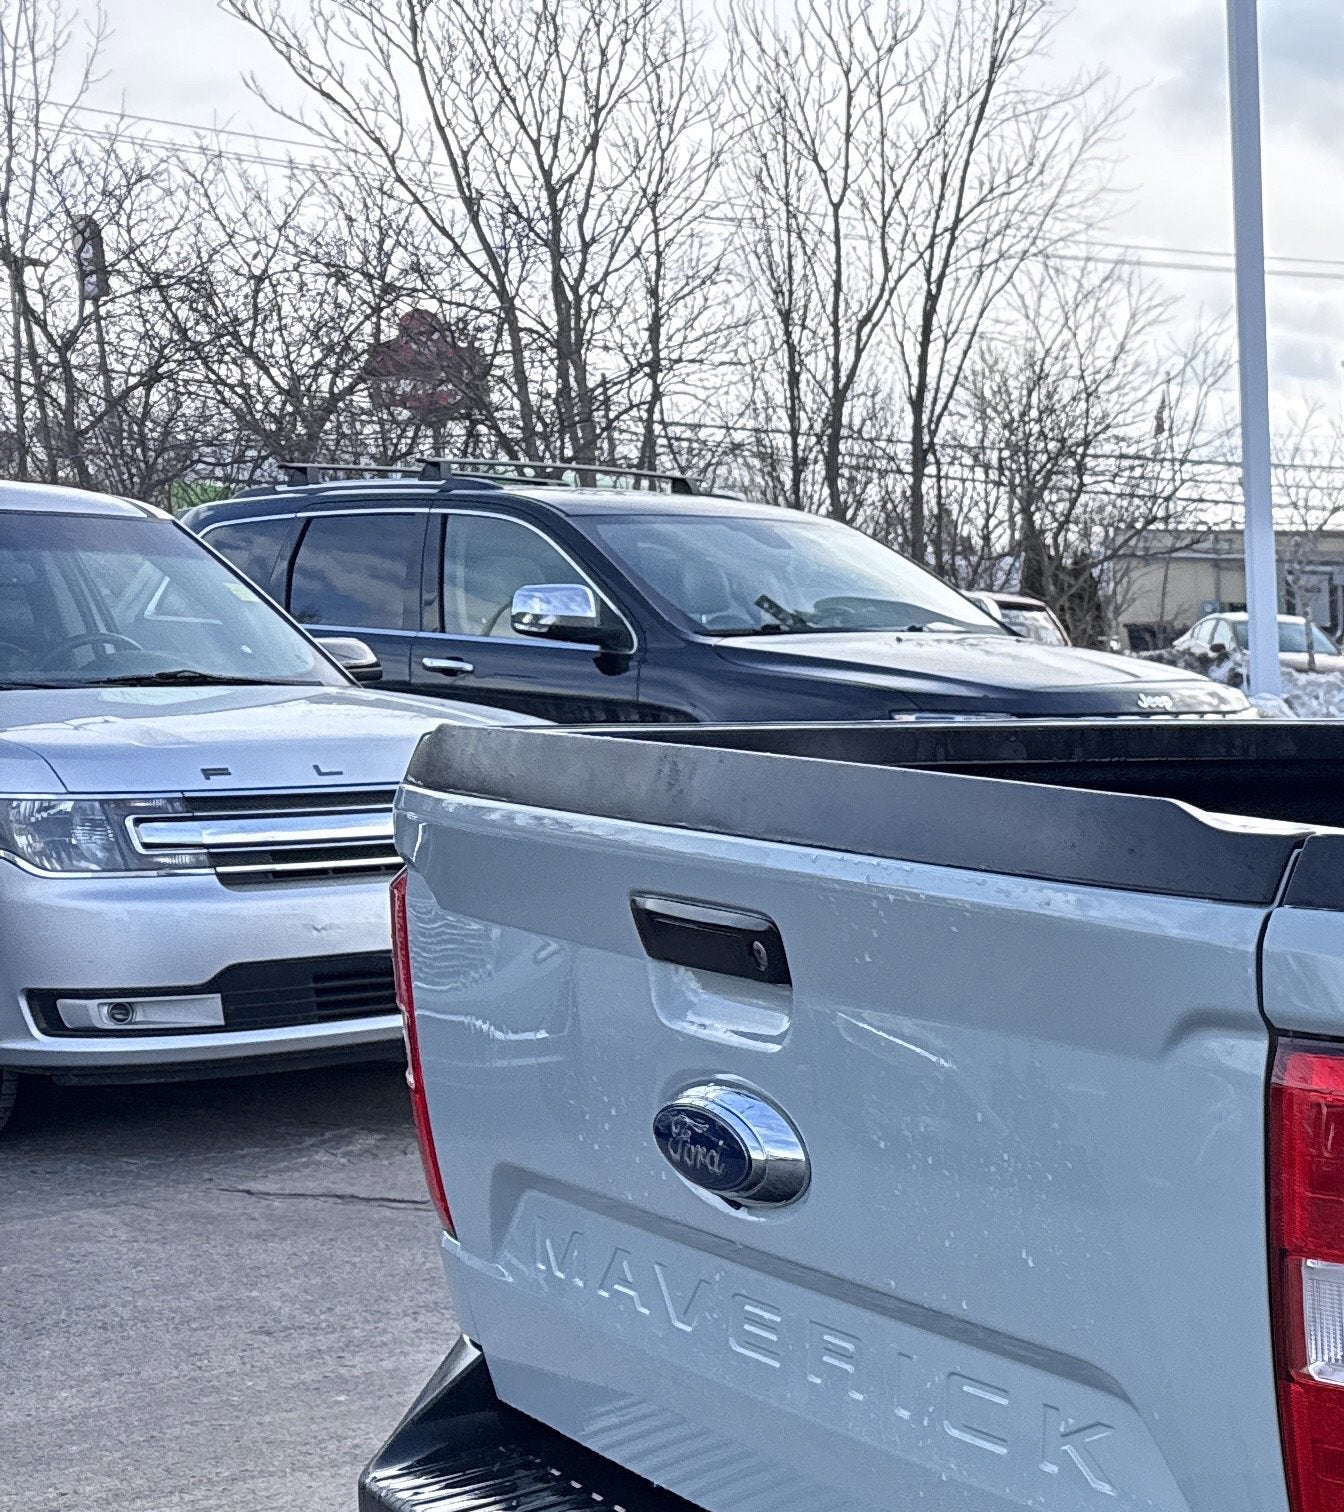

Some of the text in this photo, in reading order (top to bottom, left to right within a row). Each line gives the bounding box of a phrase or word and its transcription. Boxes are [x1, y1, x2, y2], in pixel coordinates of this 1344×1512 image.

[1137, 692, 1173, 712] Jeep
[666, 1113, 728, 1177] Ford
[530, 1213, 1118, 1497] MAVERICK
